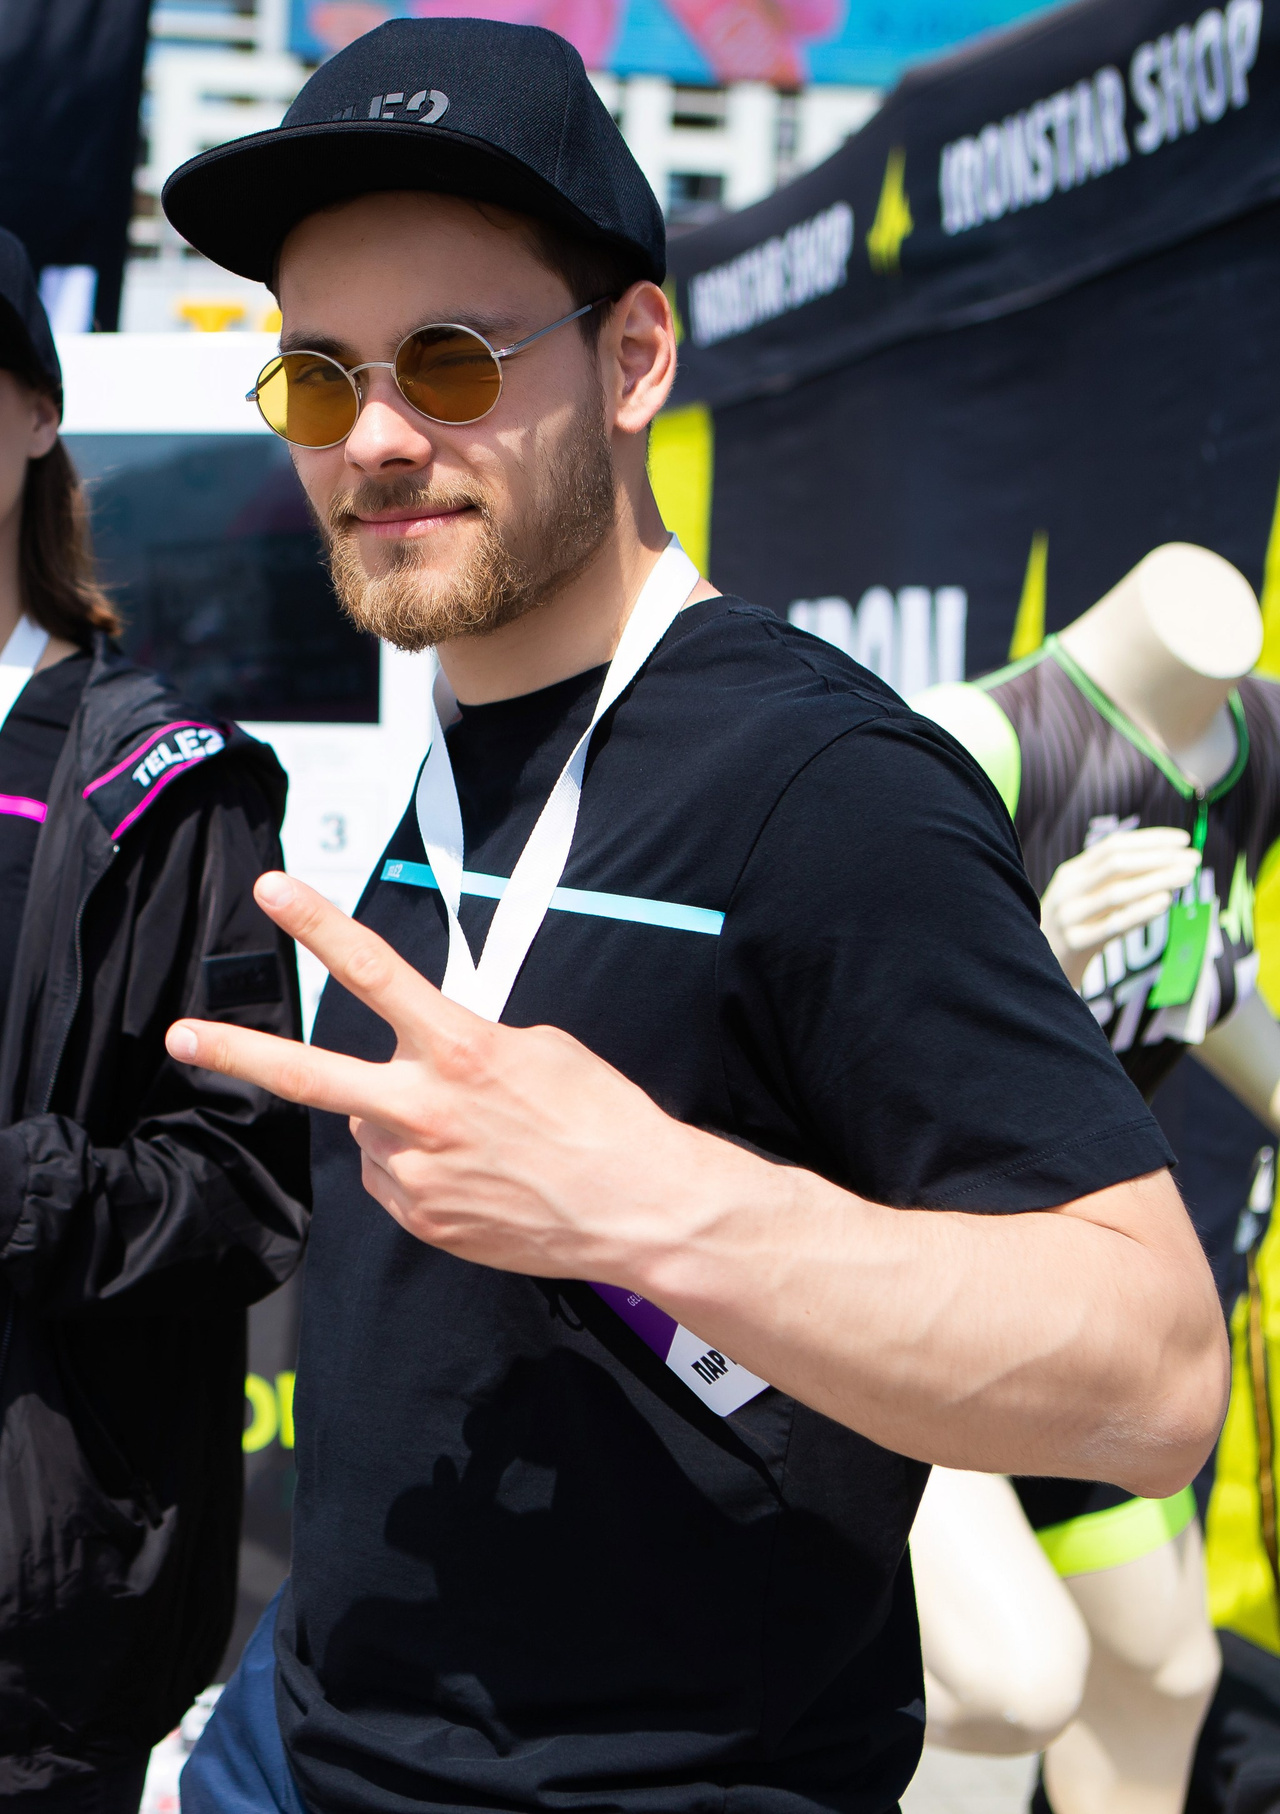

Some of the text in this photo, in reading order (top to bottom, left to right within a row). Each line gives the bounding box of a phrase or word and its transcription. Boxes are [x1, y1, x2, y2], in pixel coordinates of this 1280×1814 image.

[1129, 0, 1263, 155] SHOP
[132, 729, 225, 788] TELE2
[321, 813, 347, 853] 3
[691, 1350, 736, 1385] ПАР
